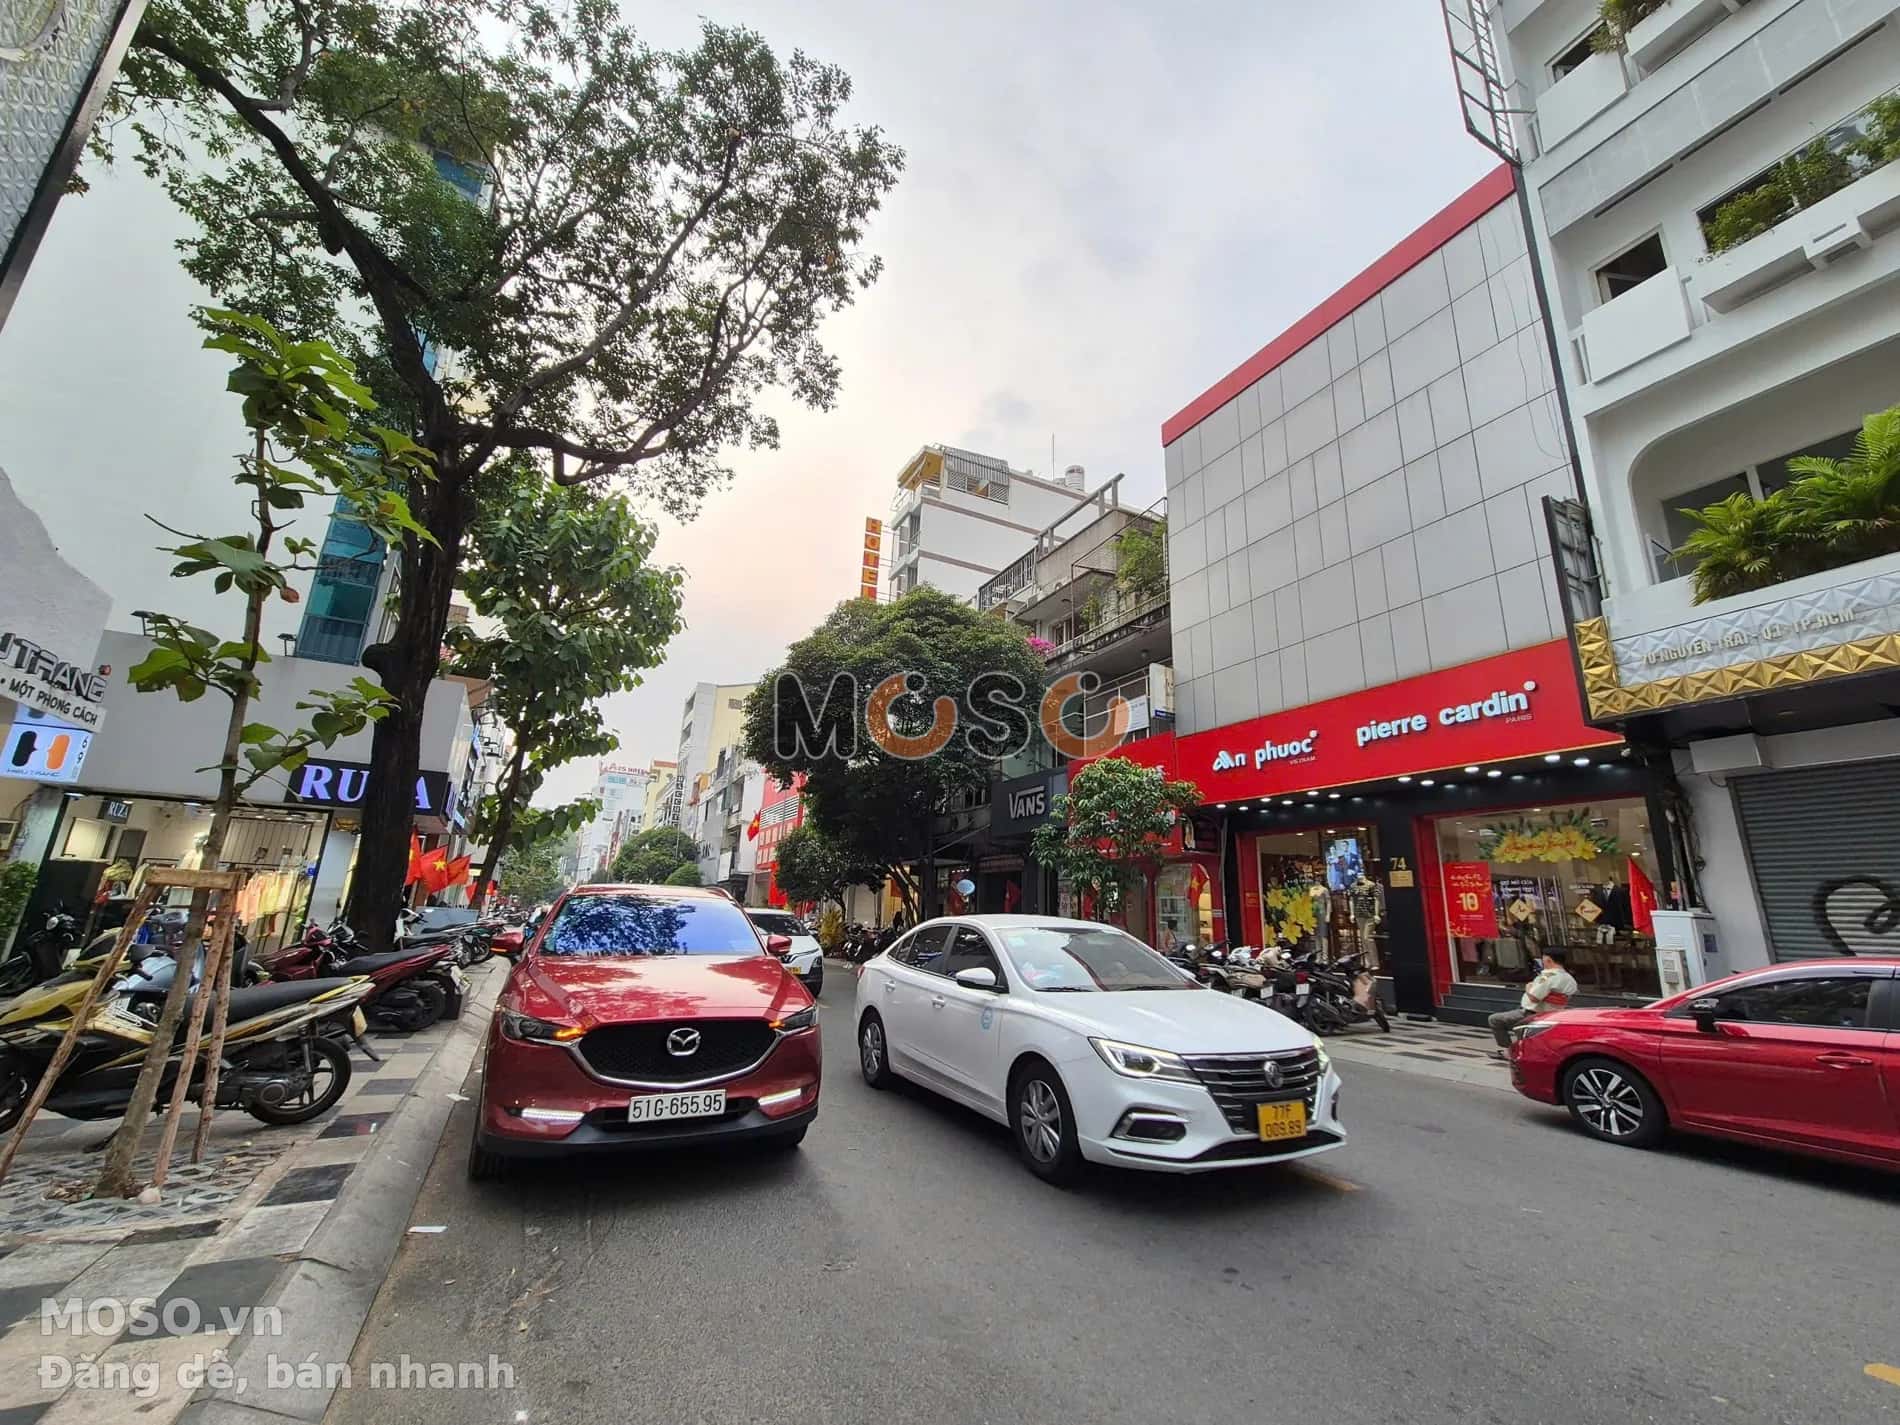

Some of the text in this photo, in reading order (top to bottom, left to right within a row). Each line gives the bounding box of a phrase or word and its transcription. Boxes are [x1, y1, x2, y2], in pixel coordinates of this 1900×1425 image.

[9, 679, 98, 726] MỘT PHONG CÁCH
[1355, 685, 1530, 747] pierre cardin
[299, 763, 432, 810] RUA
[1008, 785, 1046, 819] VANS
[1390, 856, 1407, 870] 74
[632, 1094, 723, 1119] 51G-655.95
